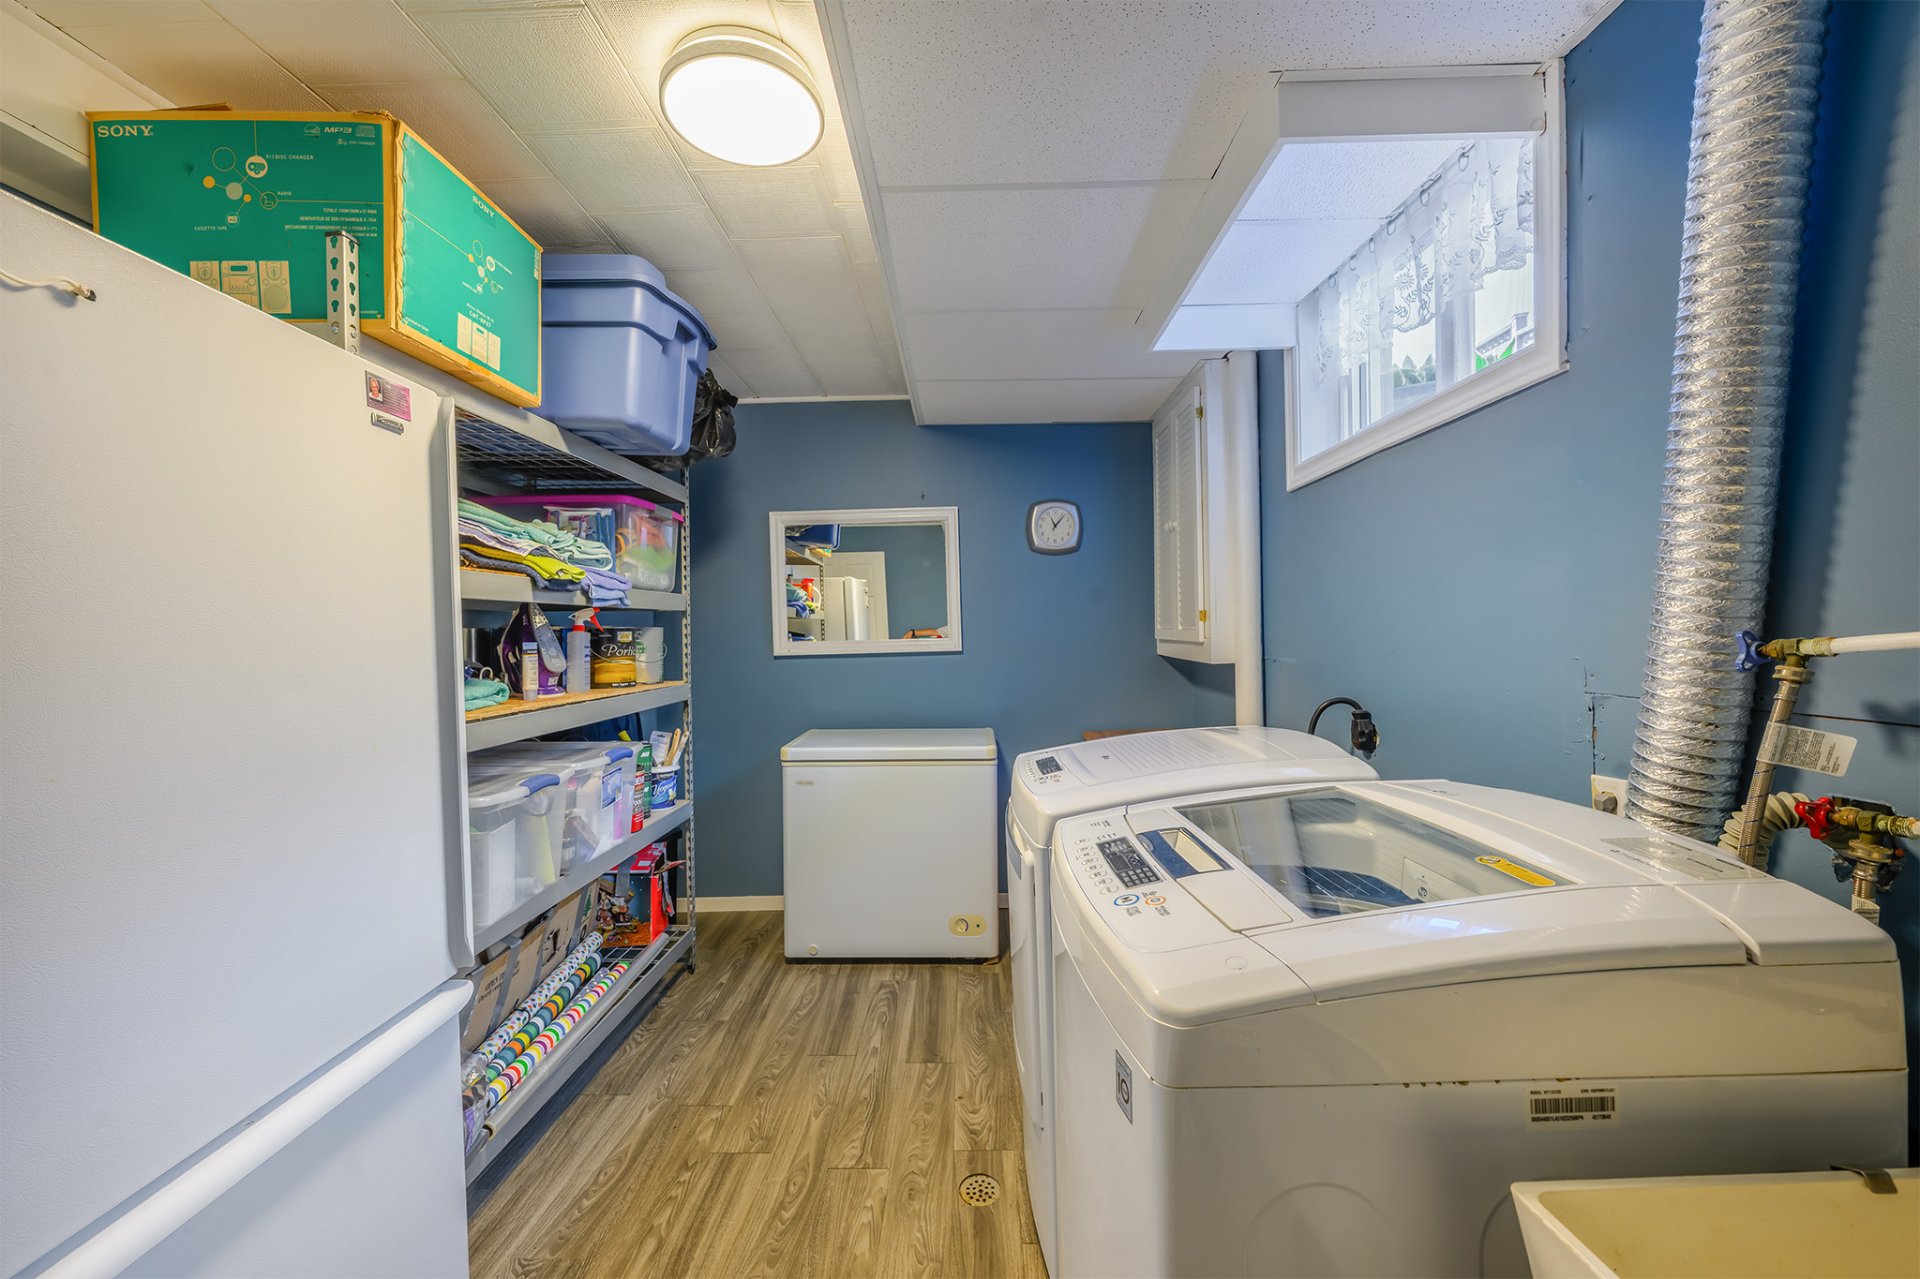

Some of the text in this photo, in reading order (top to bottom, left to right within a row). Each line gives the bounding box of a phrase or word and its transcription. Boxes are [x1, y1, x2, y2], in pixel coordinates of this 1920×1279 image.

[97, 124, 153, 138] SONY
[324, 126, 353, 134] MP3
[472, 195, 495, 218] SONY
